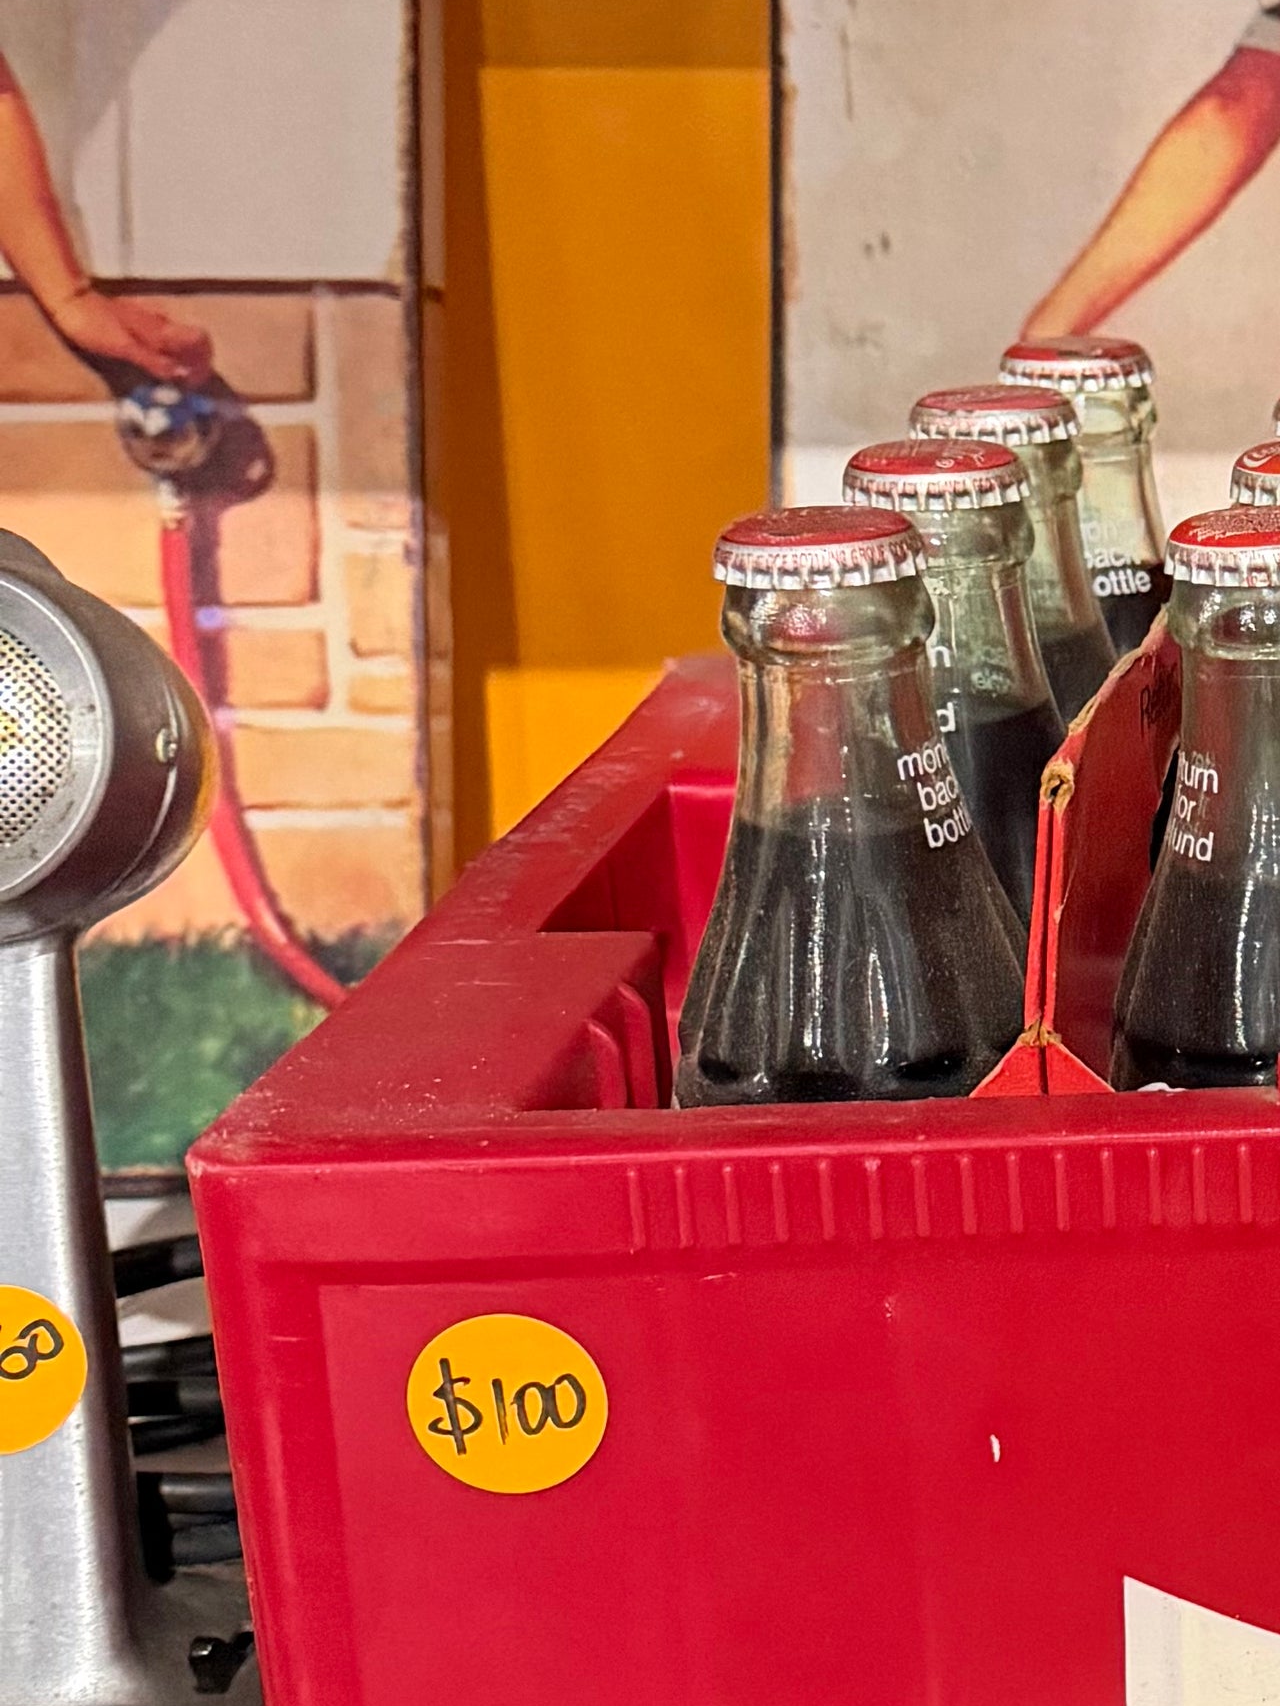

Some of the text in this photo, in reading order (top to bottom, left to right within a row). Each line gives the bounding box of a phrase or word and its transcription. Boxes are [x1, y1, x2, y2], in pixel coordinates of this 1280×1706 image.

[1092, 567, 1152, 597] ottle
[897, 742, 948, 781] mon
[917, 775, 959, 812] bac
[427, 1357, 588, 1456] $100
